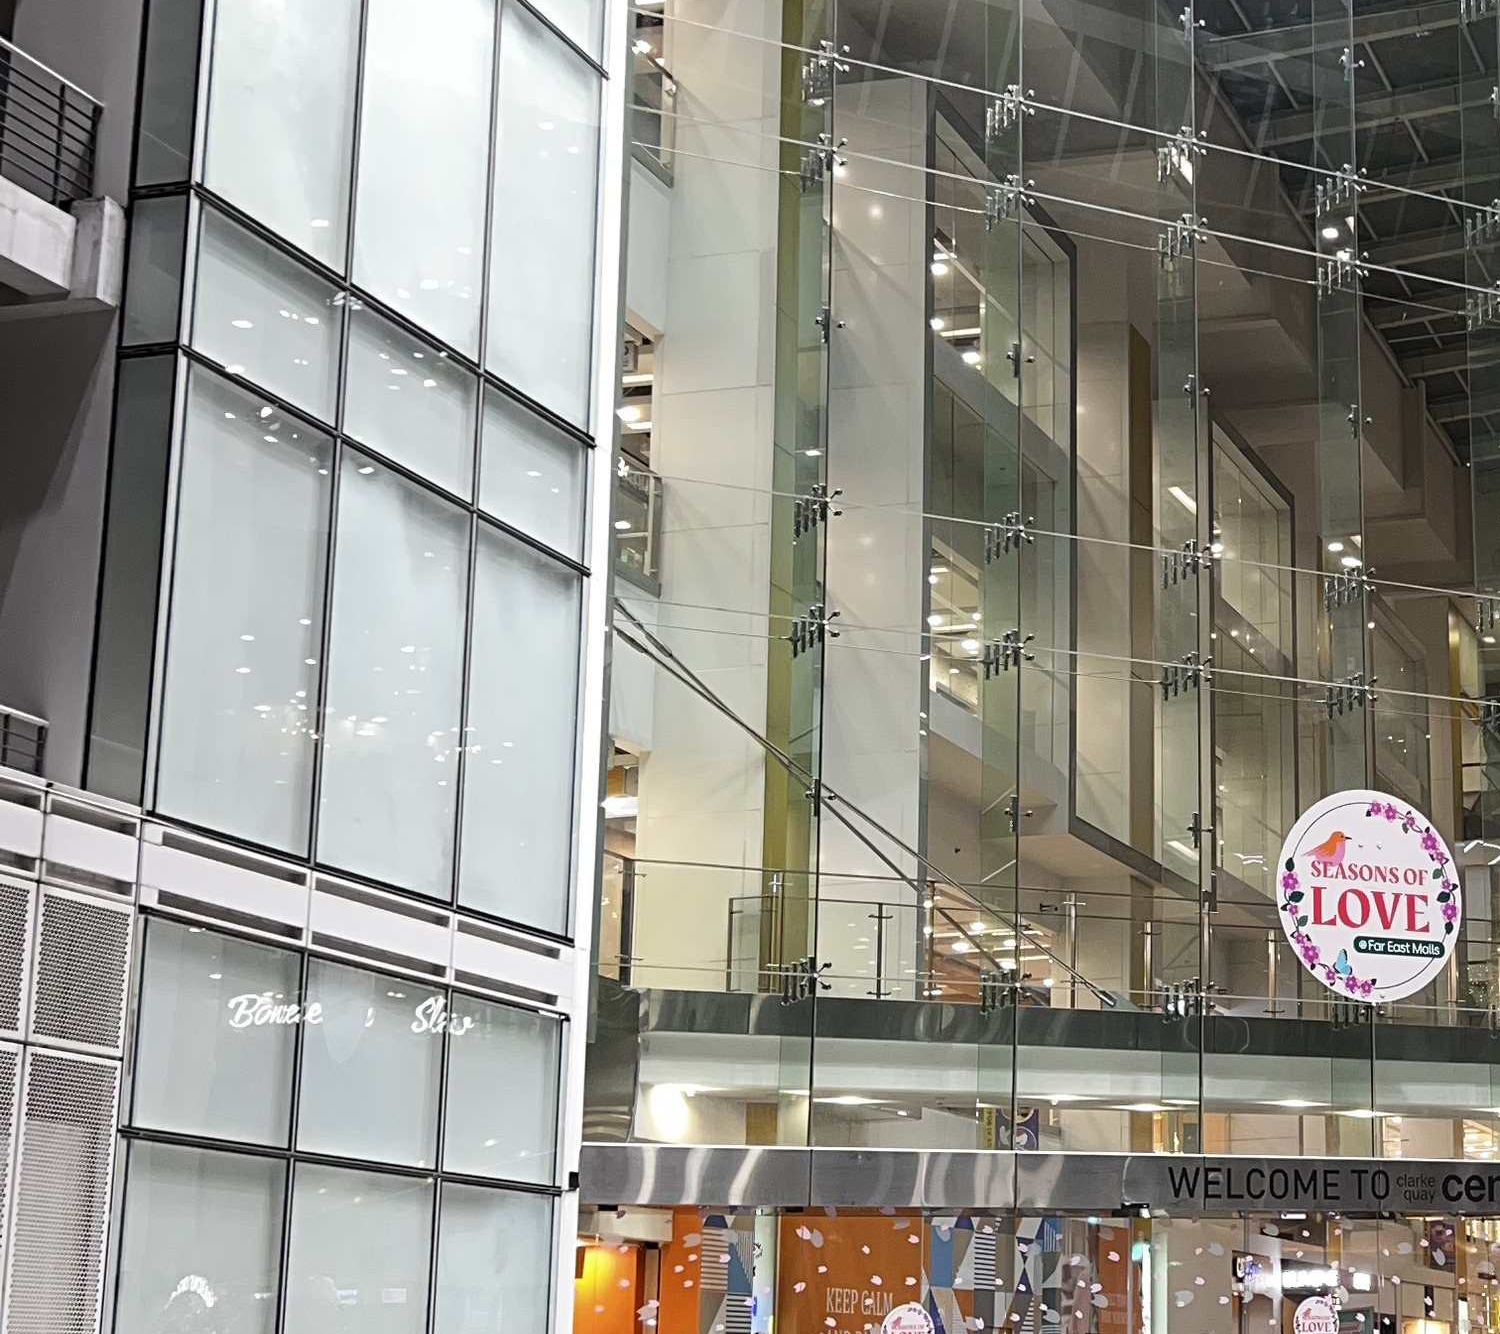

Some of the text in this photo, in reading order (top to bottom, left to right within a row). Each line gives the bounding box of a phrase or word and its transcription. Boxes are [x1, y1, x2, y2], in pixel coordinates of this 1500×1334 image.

[1310, 860, 1429, 886] SEASONS OF
[1310, 886, 1430, 933] LOVE
[1387, 941, 1411, 953] East
[1412, 943, 1441, 956] Malls
[1168, 1167, 1389, 1200] WELCOME TO
[1396, 1173, 1436, 1188] clarke
[1403, 1189, 1436, 1204] quay
[826, 1287, 894, 1316] KEEP CALM
[1301, 1322, 1332, 1333] LOVE
